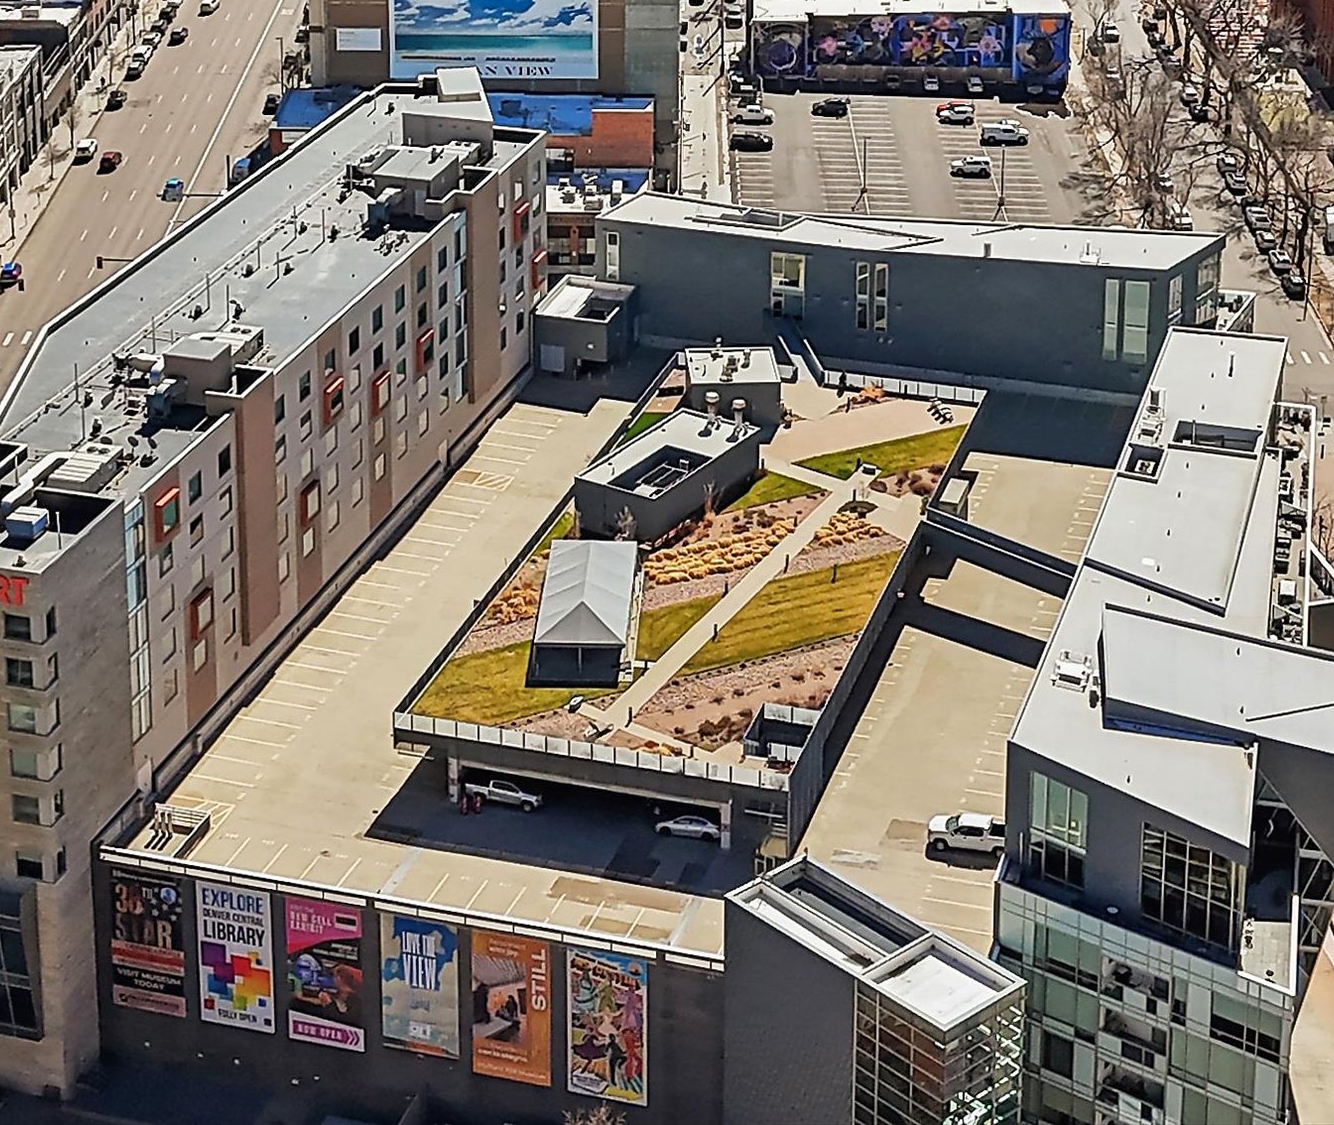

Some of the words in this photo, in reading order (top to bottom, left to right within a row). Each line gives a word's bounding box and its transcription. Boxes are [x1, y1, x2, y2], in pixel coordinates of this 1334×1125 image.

[505, 66, 552, 76] VIEW
[202, 888, 264, 915] EXPLORE
[203, 908, 231, 922] DENVER
[233, 912, 264, 927] CENTRAL
[203, 920, 265, 947] LIBRARY
[401, 931, 421, 955] LOVE
[422, 934, 436, 958] THE
[117, 967, 140, 979] VISIT
[141, 972, 182, 986] MUSEUM
[403, 954, 437, 990] VIEW
[531, 949, 547, 1011] STILL
[134, 979, 164, 990] TODAY
[238, 1011, 258, 1024] OPEN
[320, 1027, 343, 1040] OPEN
